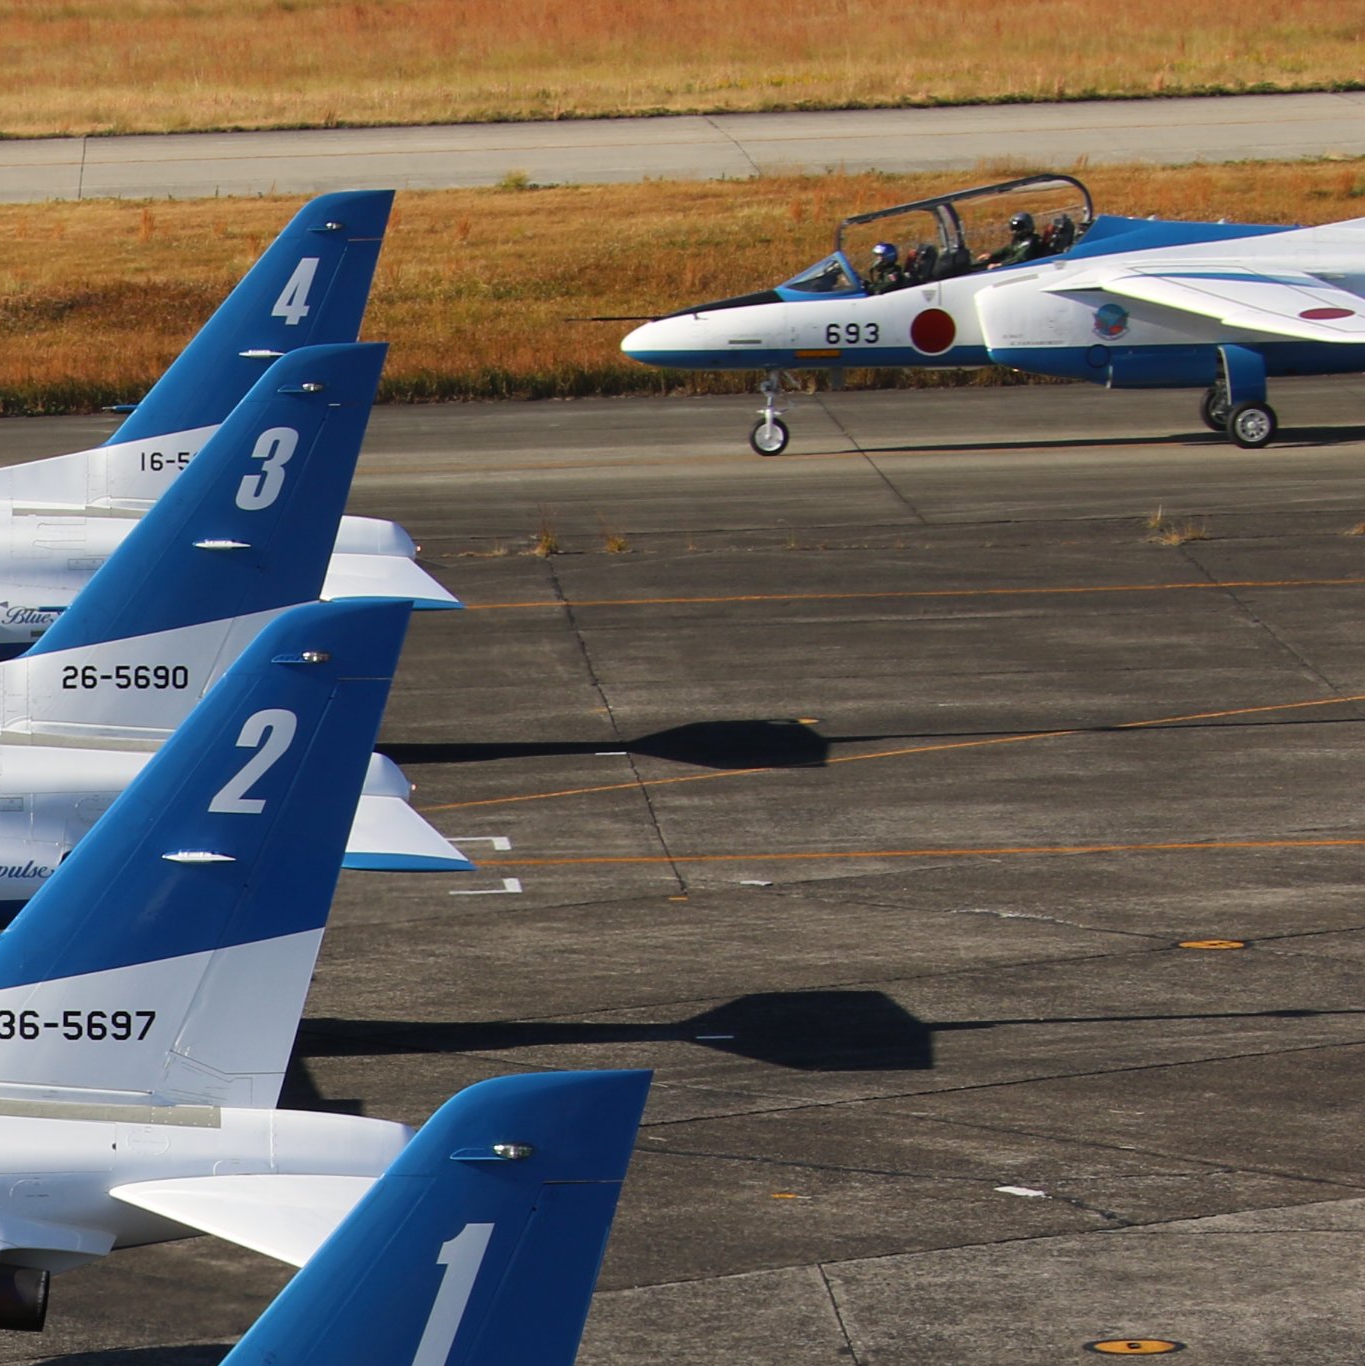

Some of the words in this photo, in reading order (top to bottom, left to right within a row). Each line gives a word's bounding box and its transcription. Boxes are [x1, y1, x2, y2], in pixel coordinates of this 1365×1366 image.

[271, 257, 319, 325] 4
[825, 322, 880, 344] 693
[141, 452, 198, 471] 16-5
[235, 426, 299, 511] 3
[1, 606, 51, 625] Blue
[62, 665, 188, 689] 26-5690
[207, 708, 297, 813] 2
